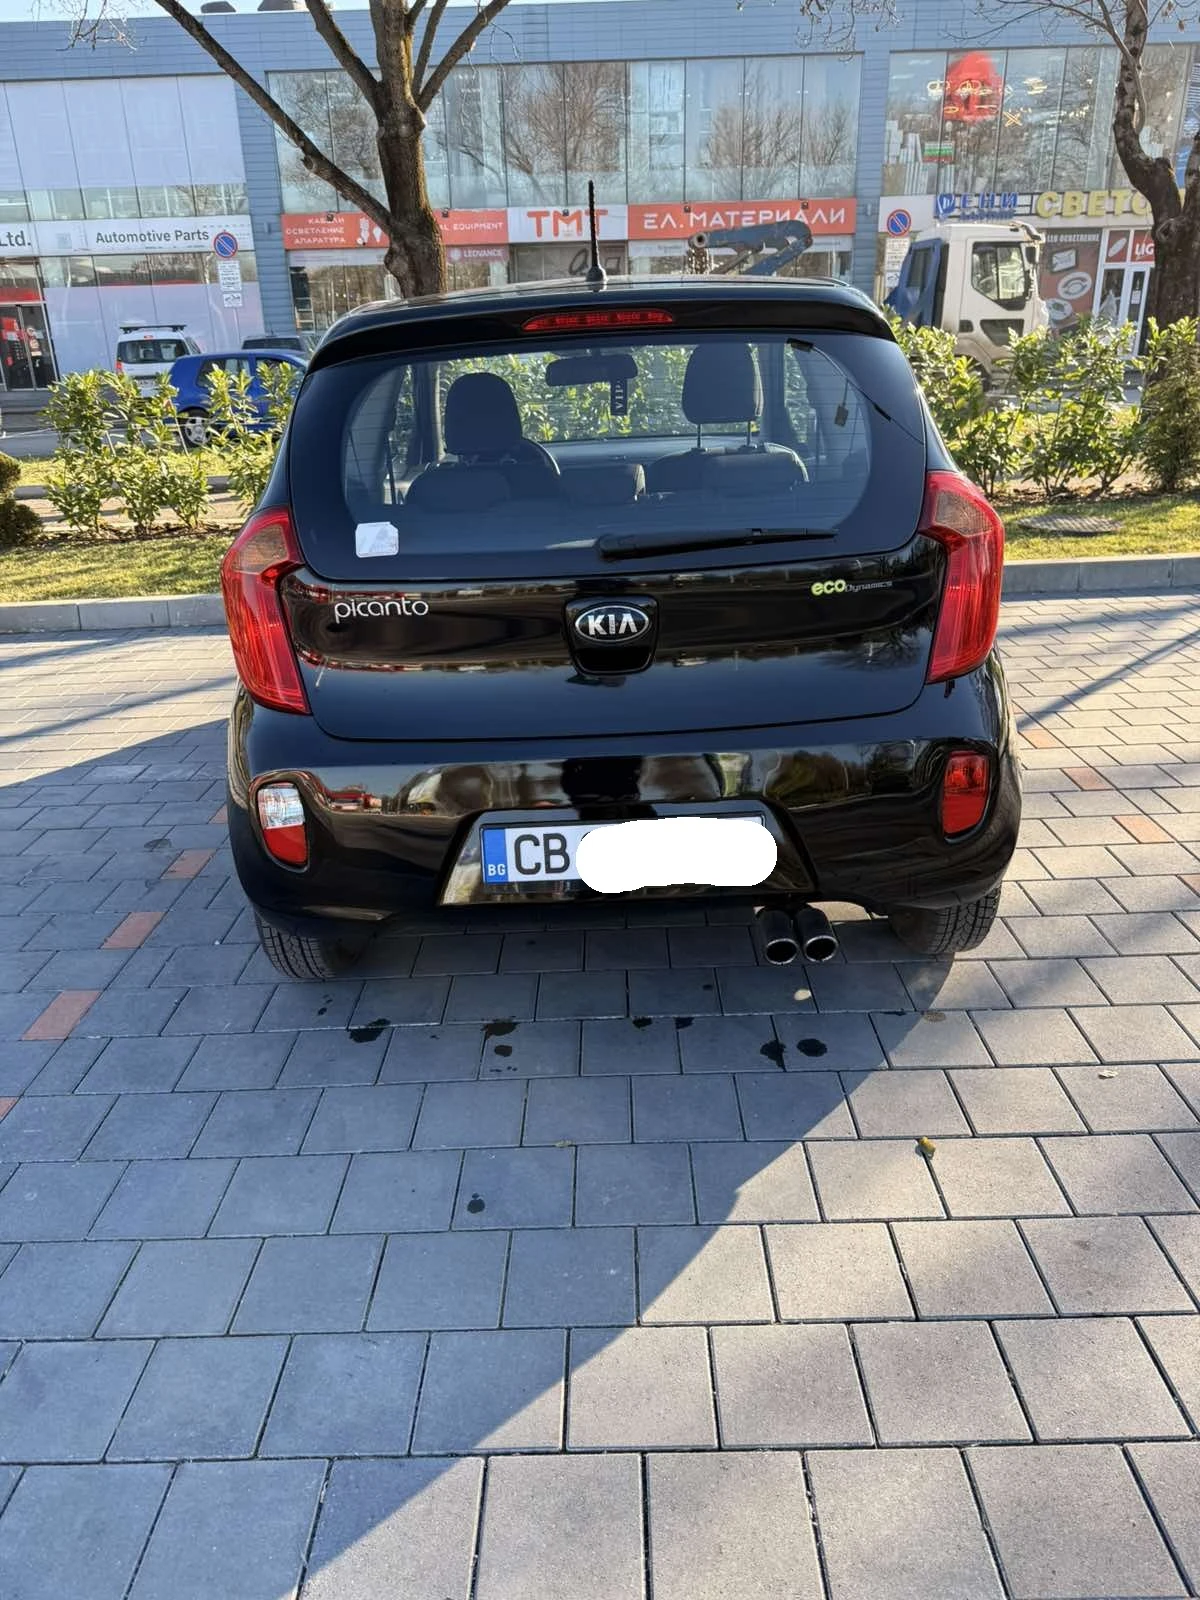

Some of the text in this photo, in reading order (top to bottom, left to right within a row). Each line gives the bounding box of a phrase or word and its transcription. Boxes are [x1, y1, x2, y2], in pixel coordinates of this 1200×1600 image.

[1036, 189, 1152, 218] СВЕТО
[452, 222, 504, 231] EQUIPMENT
[643, 207, 845, 230] ЕЛ. МАТЕРИАЛИ
[95, 229, 209, 244] Automotive Parts
[1135, 243, 1155, 255] LIG
[334, 597, 429, 624] picanto
[587, 613, 638, 635] KIA
[514, 832, 570, 875] CB
[488, 863, 506, 876] BG
